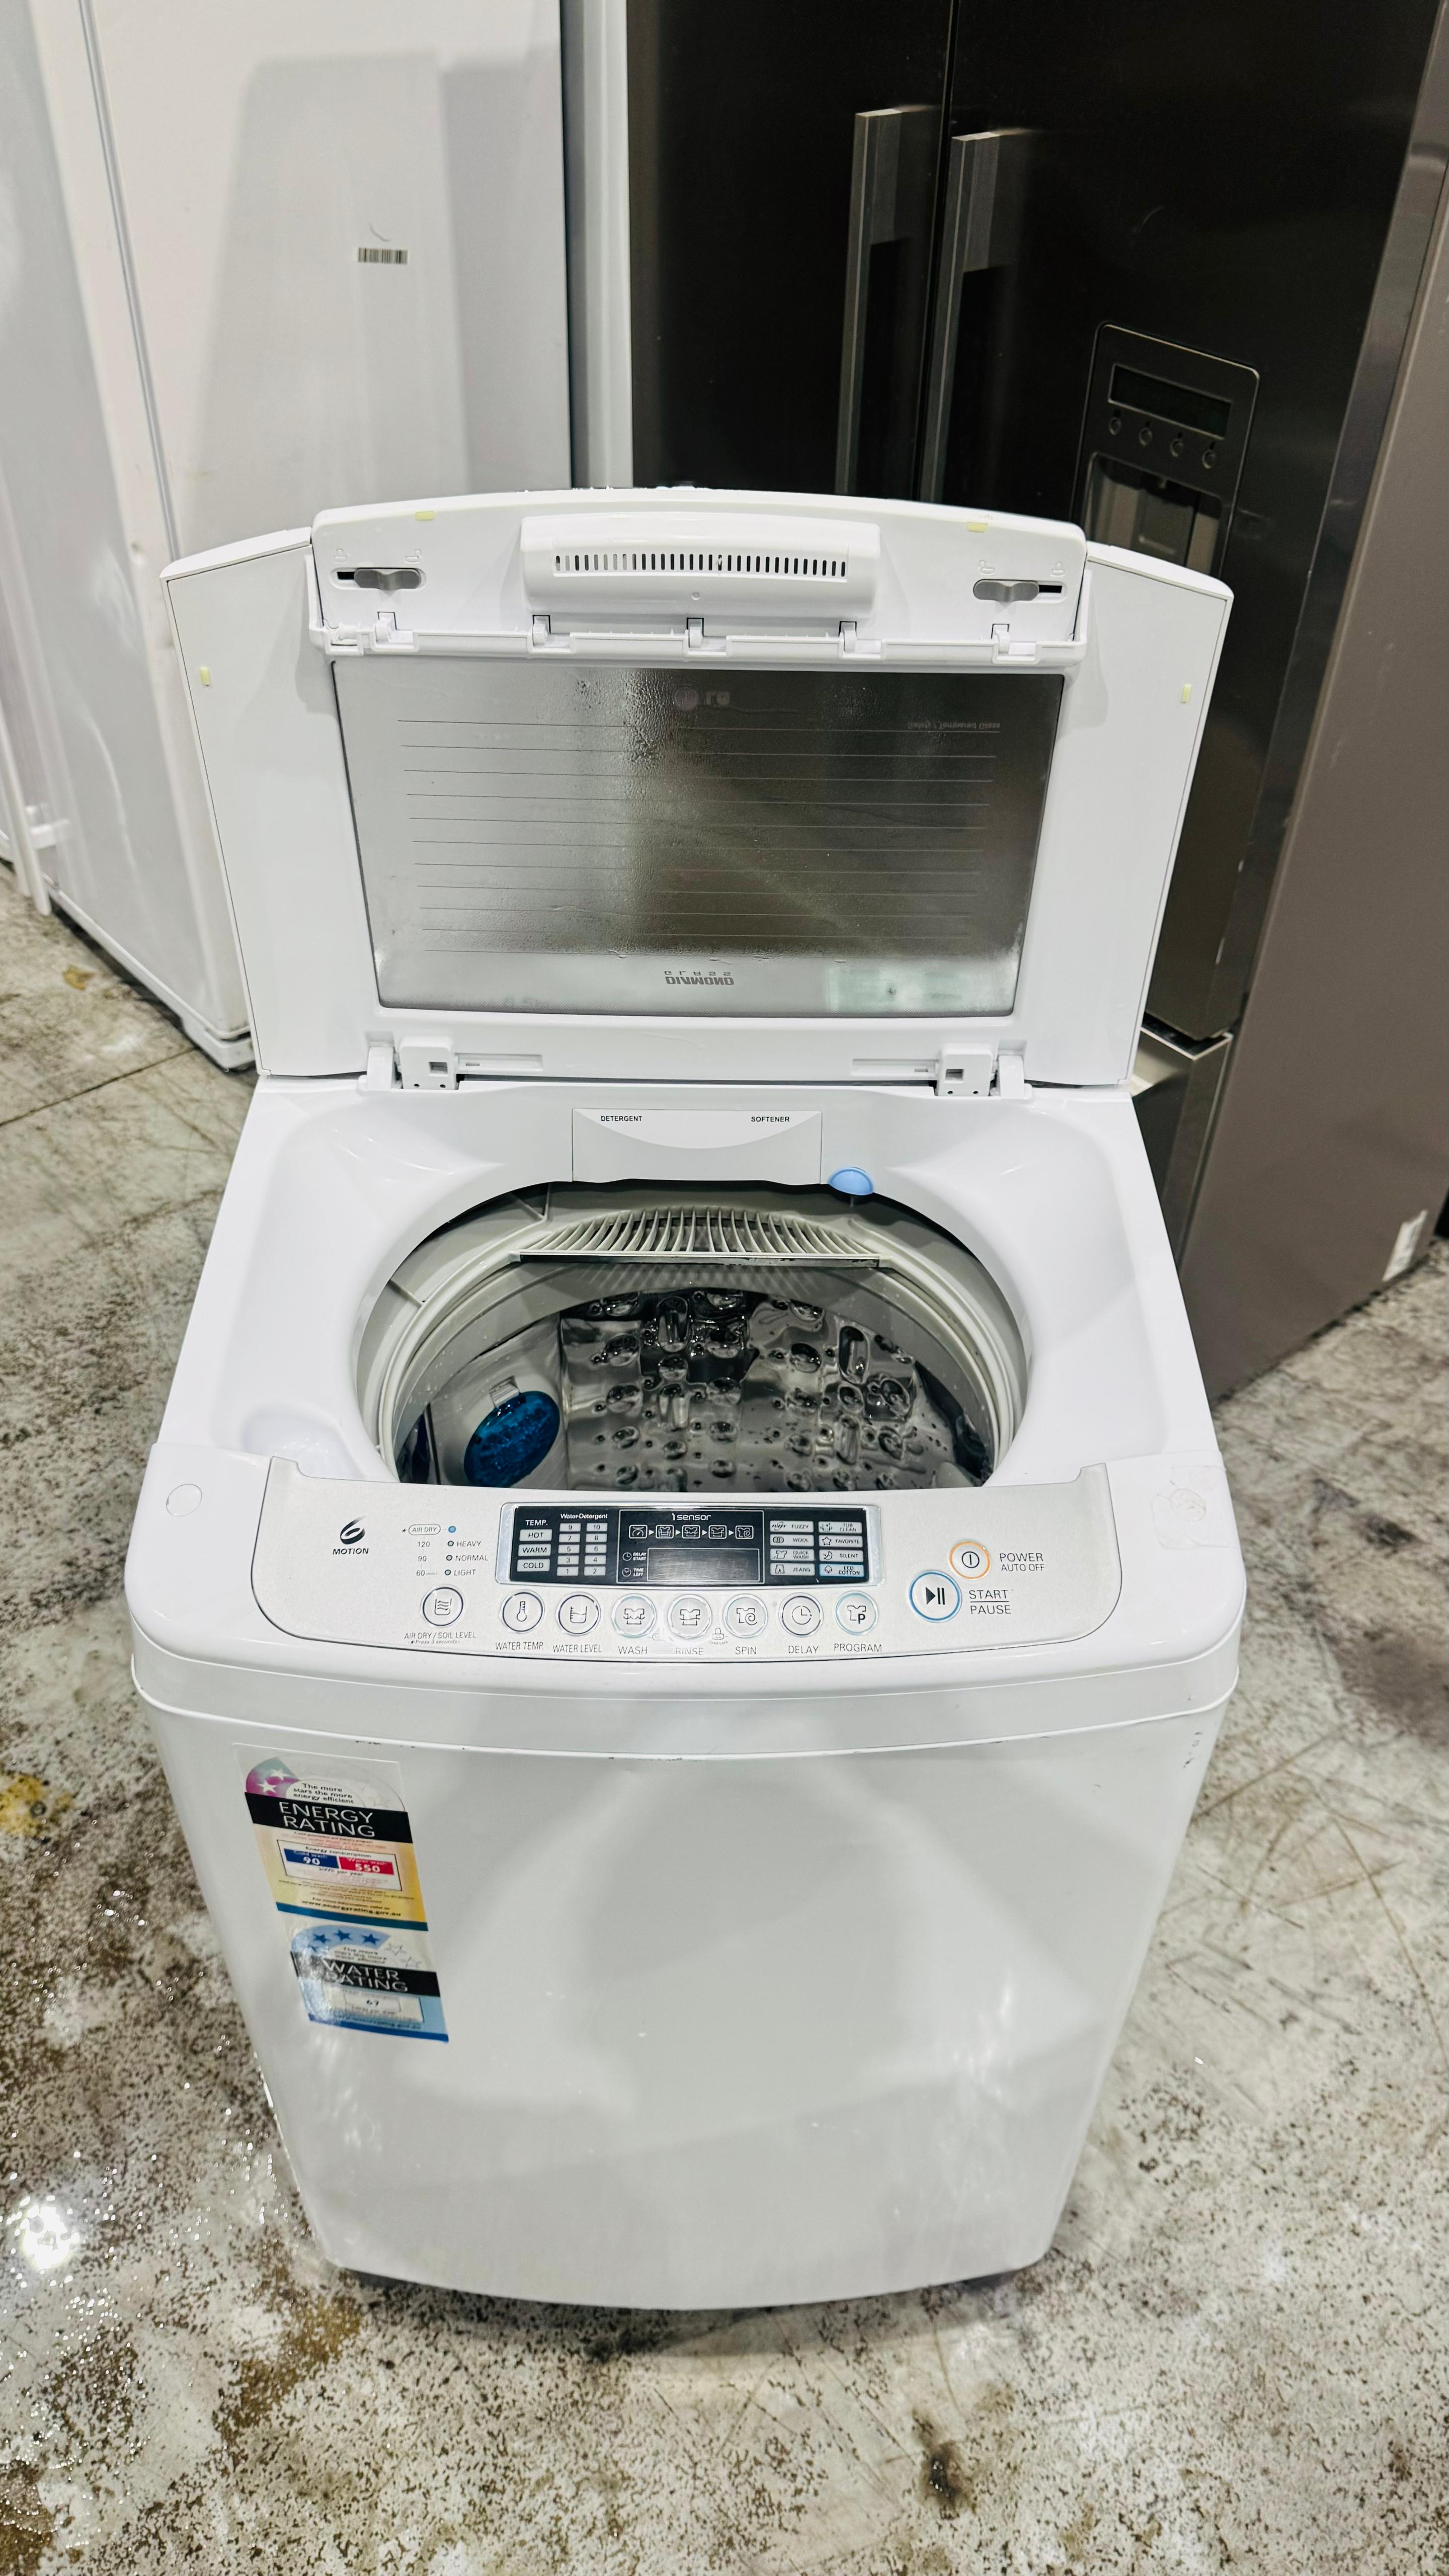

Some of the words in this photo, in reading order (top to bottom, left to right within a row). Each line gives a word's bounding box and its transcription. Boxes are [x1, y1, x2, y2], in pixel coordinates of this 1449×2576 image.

[1000, 1553, 1043, 1562] POWER
[1001, 1564, 1026, 1572] AUTO
[969, 1590, 1008, 1599] START
[971, 1605, 1011, 1615] PAUSE
[495, 1642, 521, 1650] WATER
[553, 1645, 579, 1653] WATER
[581, 1644, 602, 1653] LEVEL
[618, 1646, 647, 1654] WASH
[735, 1646, 757, 1655] SPIN
[788, 1645, 819, 1654] DELAY
[834, 1644, 882, 1653] PROGRAM
[676, 1647, 704, 1655] RINSE
[279, 1801, 373, 1824] ENERGY
[283, 1815, 375, 1837] RATING
[303, 1857, 320, 1866] 90
[355, 1863, 381, 1873] 550
[323, 1959, 400, 1980] WATER
